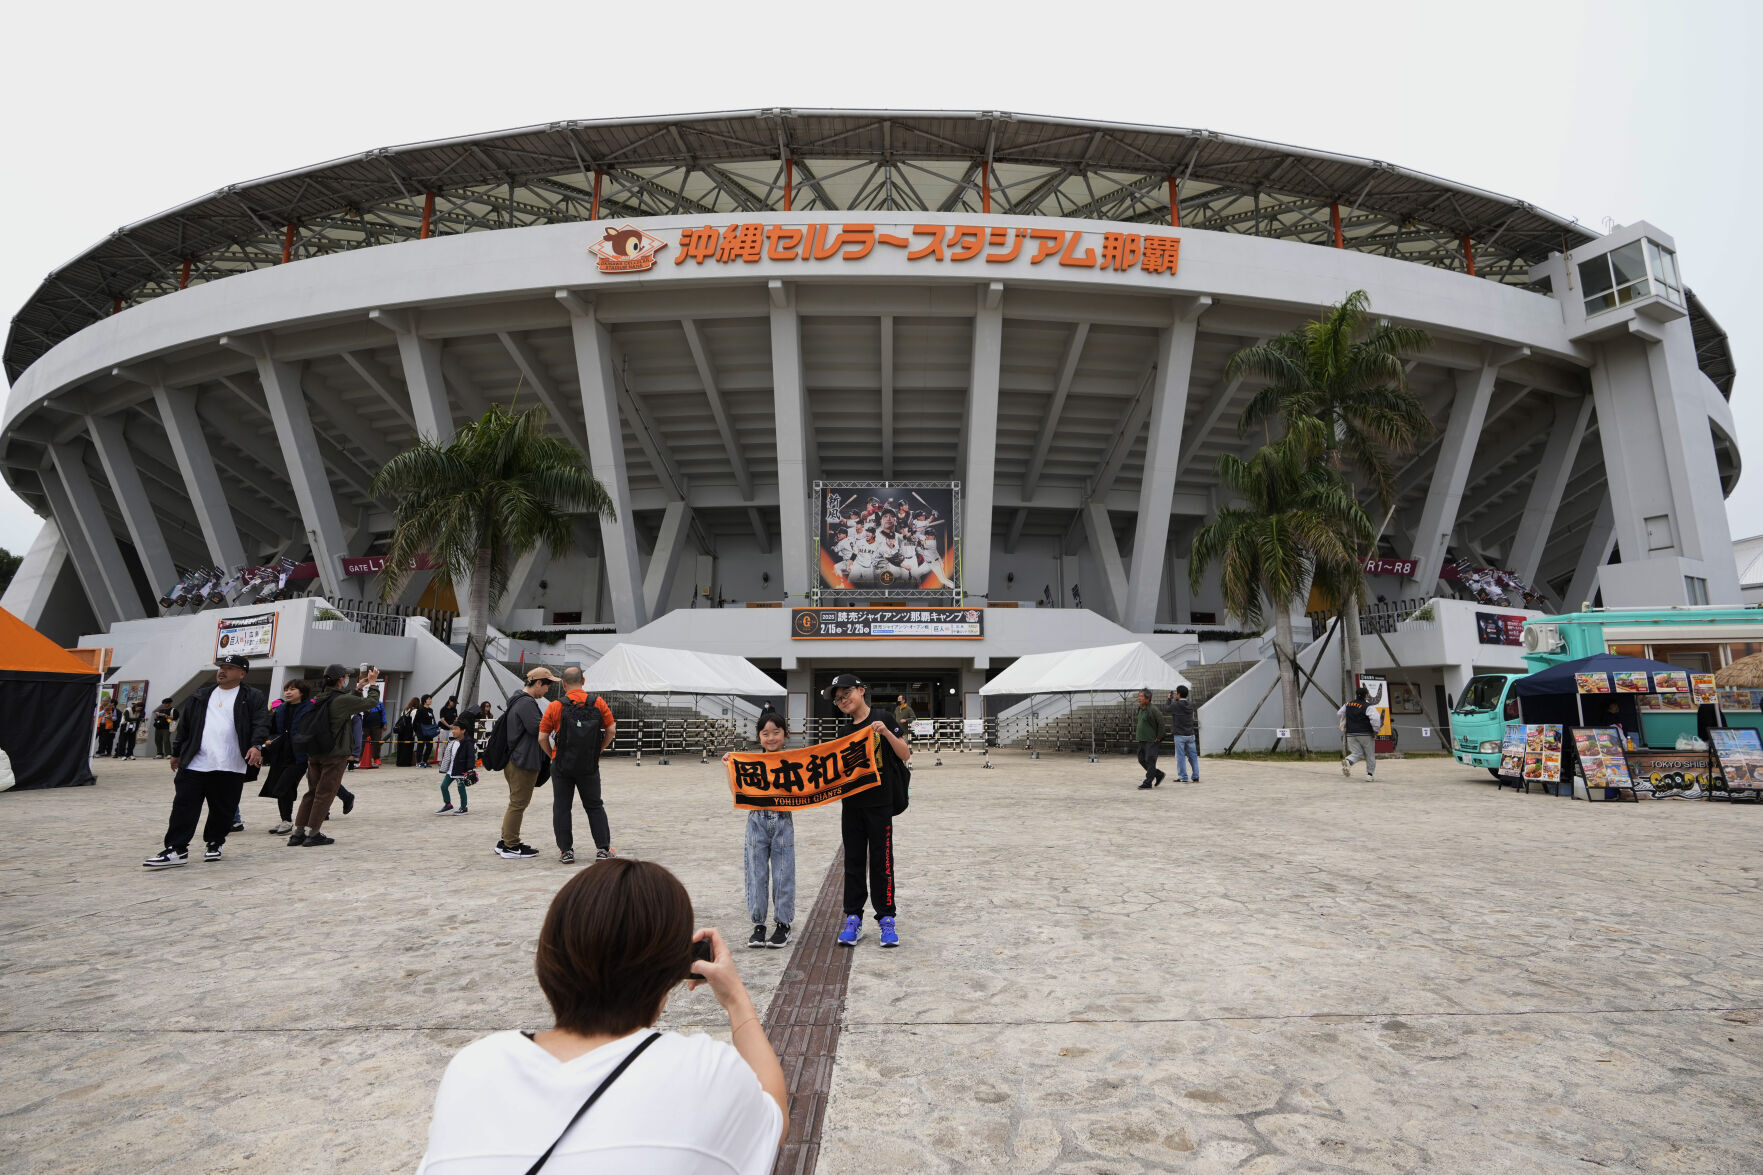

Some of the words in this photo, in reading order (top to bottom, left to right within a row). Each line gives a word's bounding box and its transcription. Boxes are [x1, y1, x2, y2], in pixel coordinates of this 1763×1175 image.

[349, 564, 368, 572] GATE
[733, 737, 871, 793] 岡本和真
[1650, 760, 1682, 768] TOKYO
[774, 797, 811, 806] YOMIURI
[813, 787, 842, 801] GIANTS
